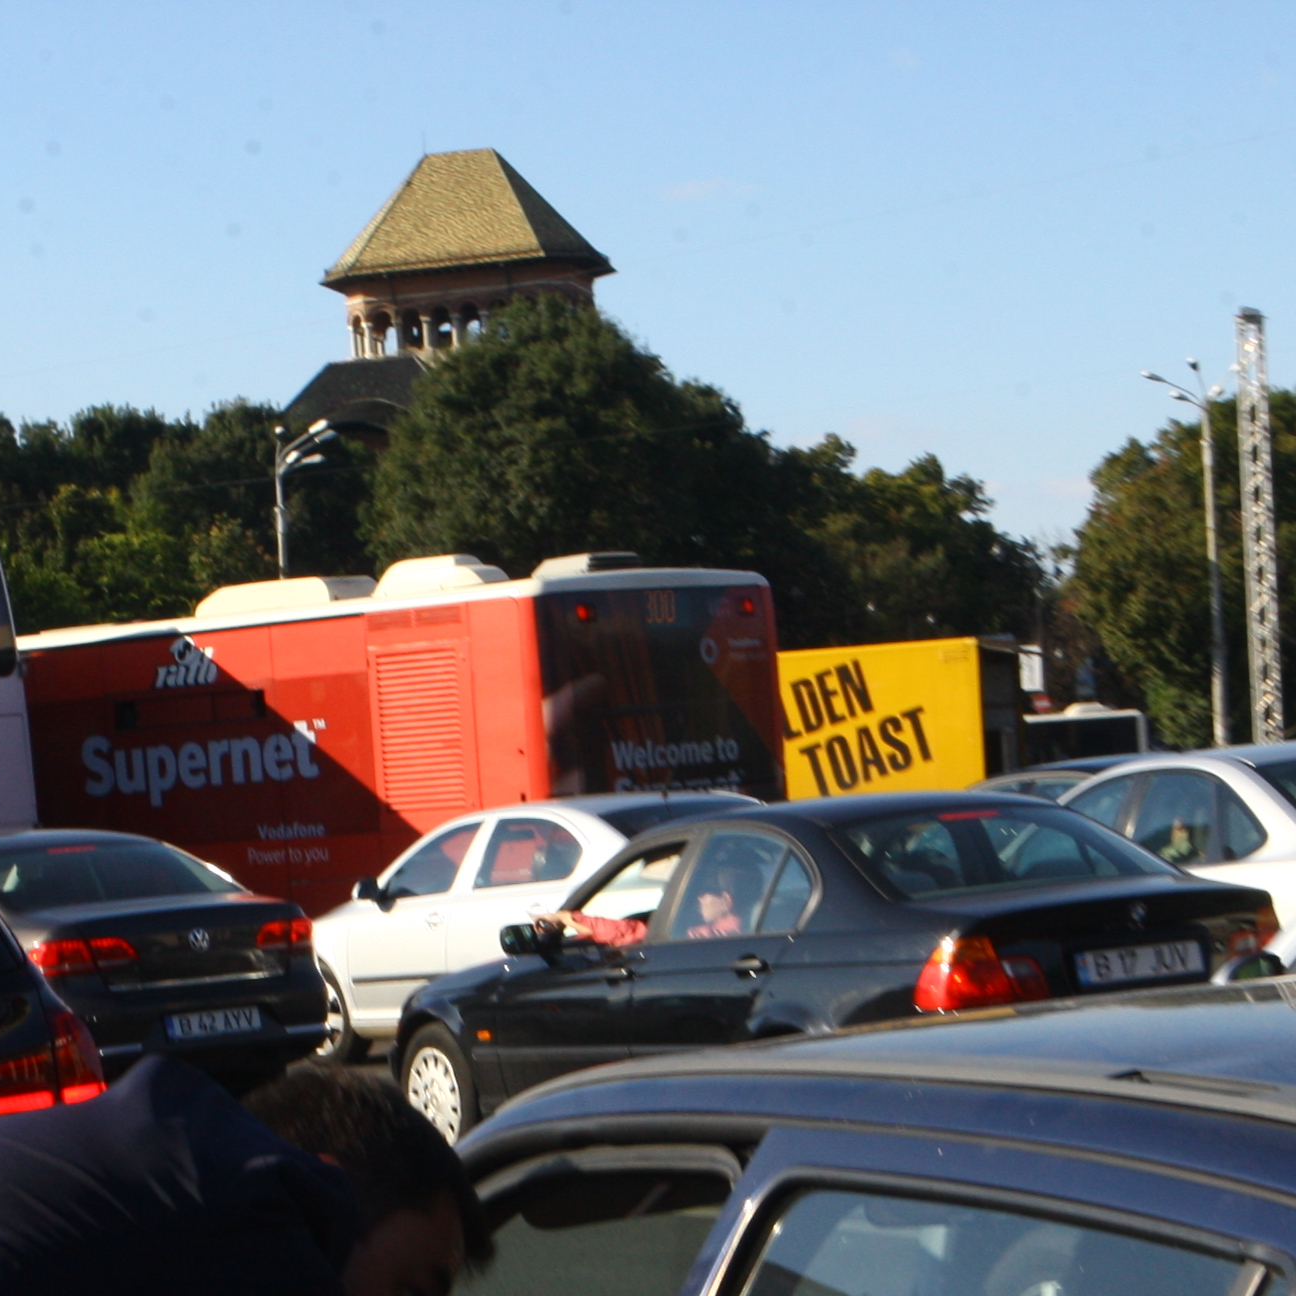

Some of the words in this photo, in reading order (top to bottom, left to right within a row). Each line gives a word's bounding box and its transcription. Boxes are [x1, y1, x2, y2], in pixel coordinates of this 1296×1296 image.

[81, 720, 320, 808] Supernet
[610, 739, 715, 770] Welcome
[714, 734, 740, 762] to
[799, 705, 934, 798] TOAST
[256, 822, 326, 840] Vodafone
[247, 847, 285, 866] Power
[288, 847, 303, 863] to
[304, 846, 329, 868] you
[1091, 950, 1112, 980] B
